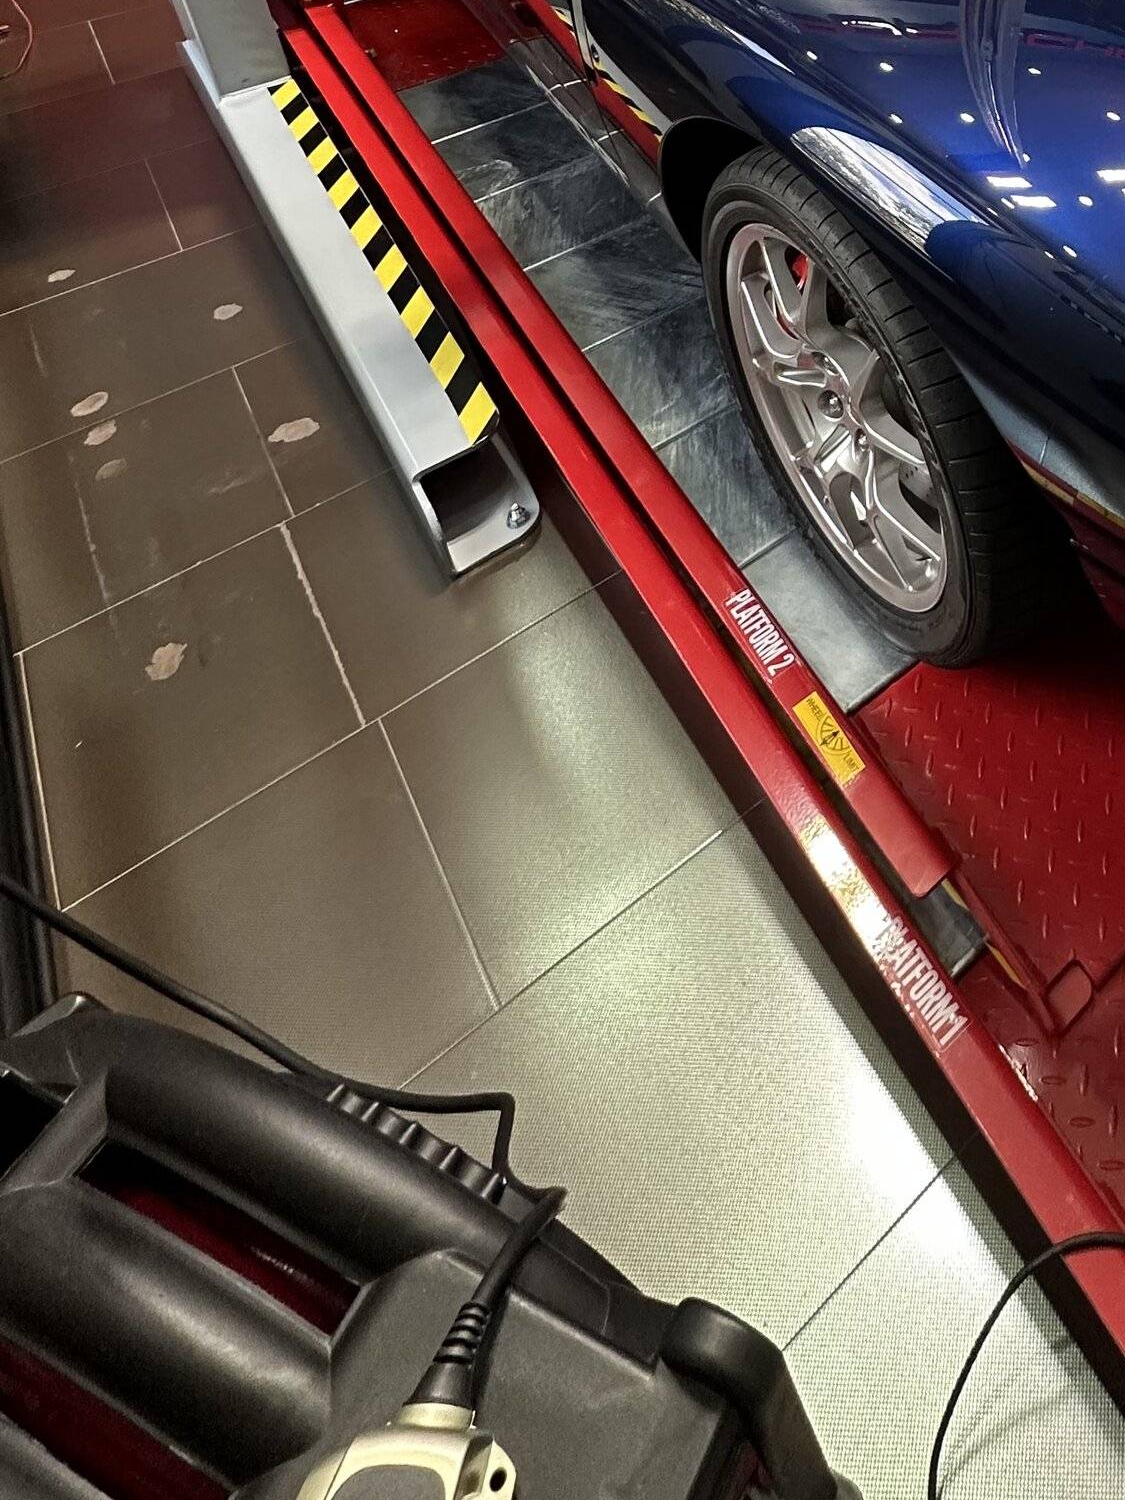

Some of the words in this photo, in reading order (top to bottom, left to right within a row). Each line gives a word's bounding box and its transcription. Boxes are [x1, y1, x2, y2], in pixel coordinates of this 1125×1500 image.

[725, 588, 789, 666] PLATFORM
[767, 653, 795, 677] 2
[806, 698, 825, 722] WHEEL
[843, 750, 860, 773] LIMIT
[874, 916, 960, 1034] PLATFORM
[940, 1017, 968, 1046] 1
